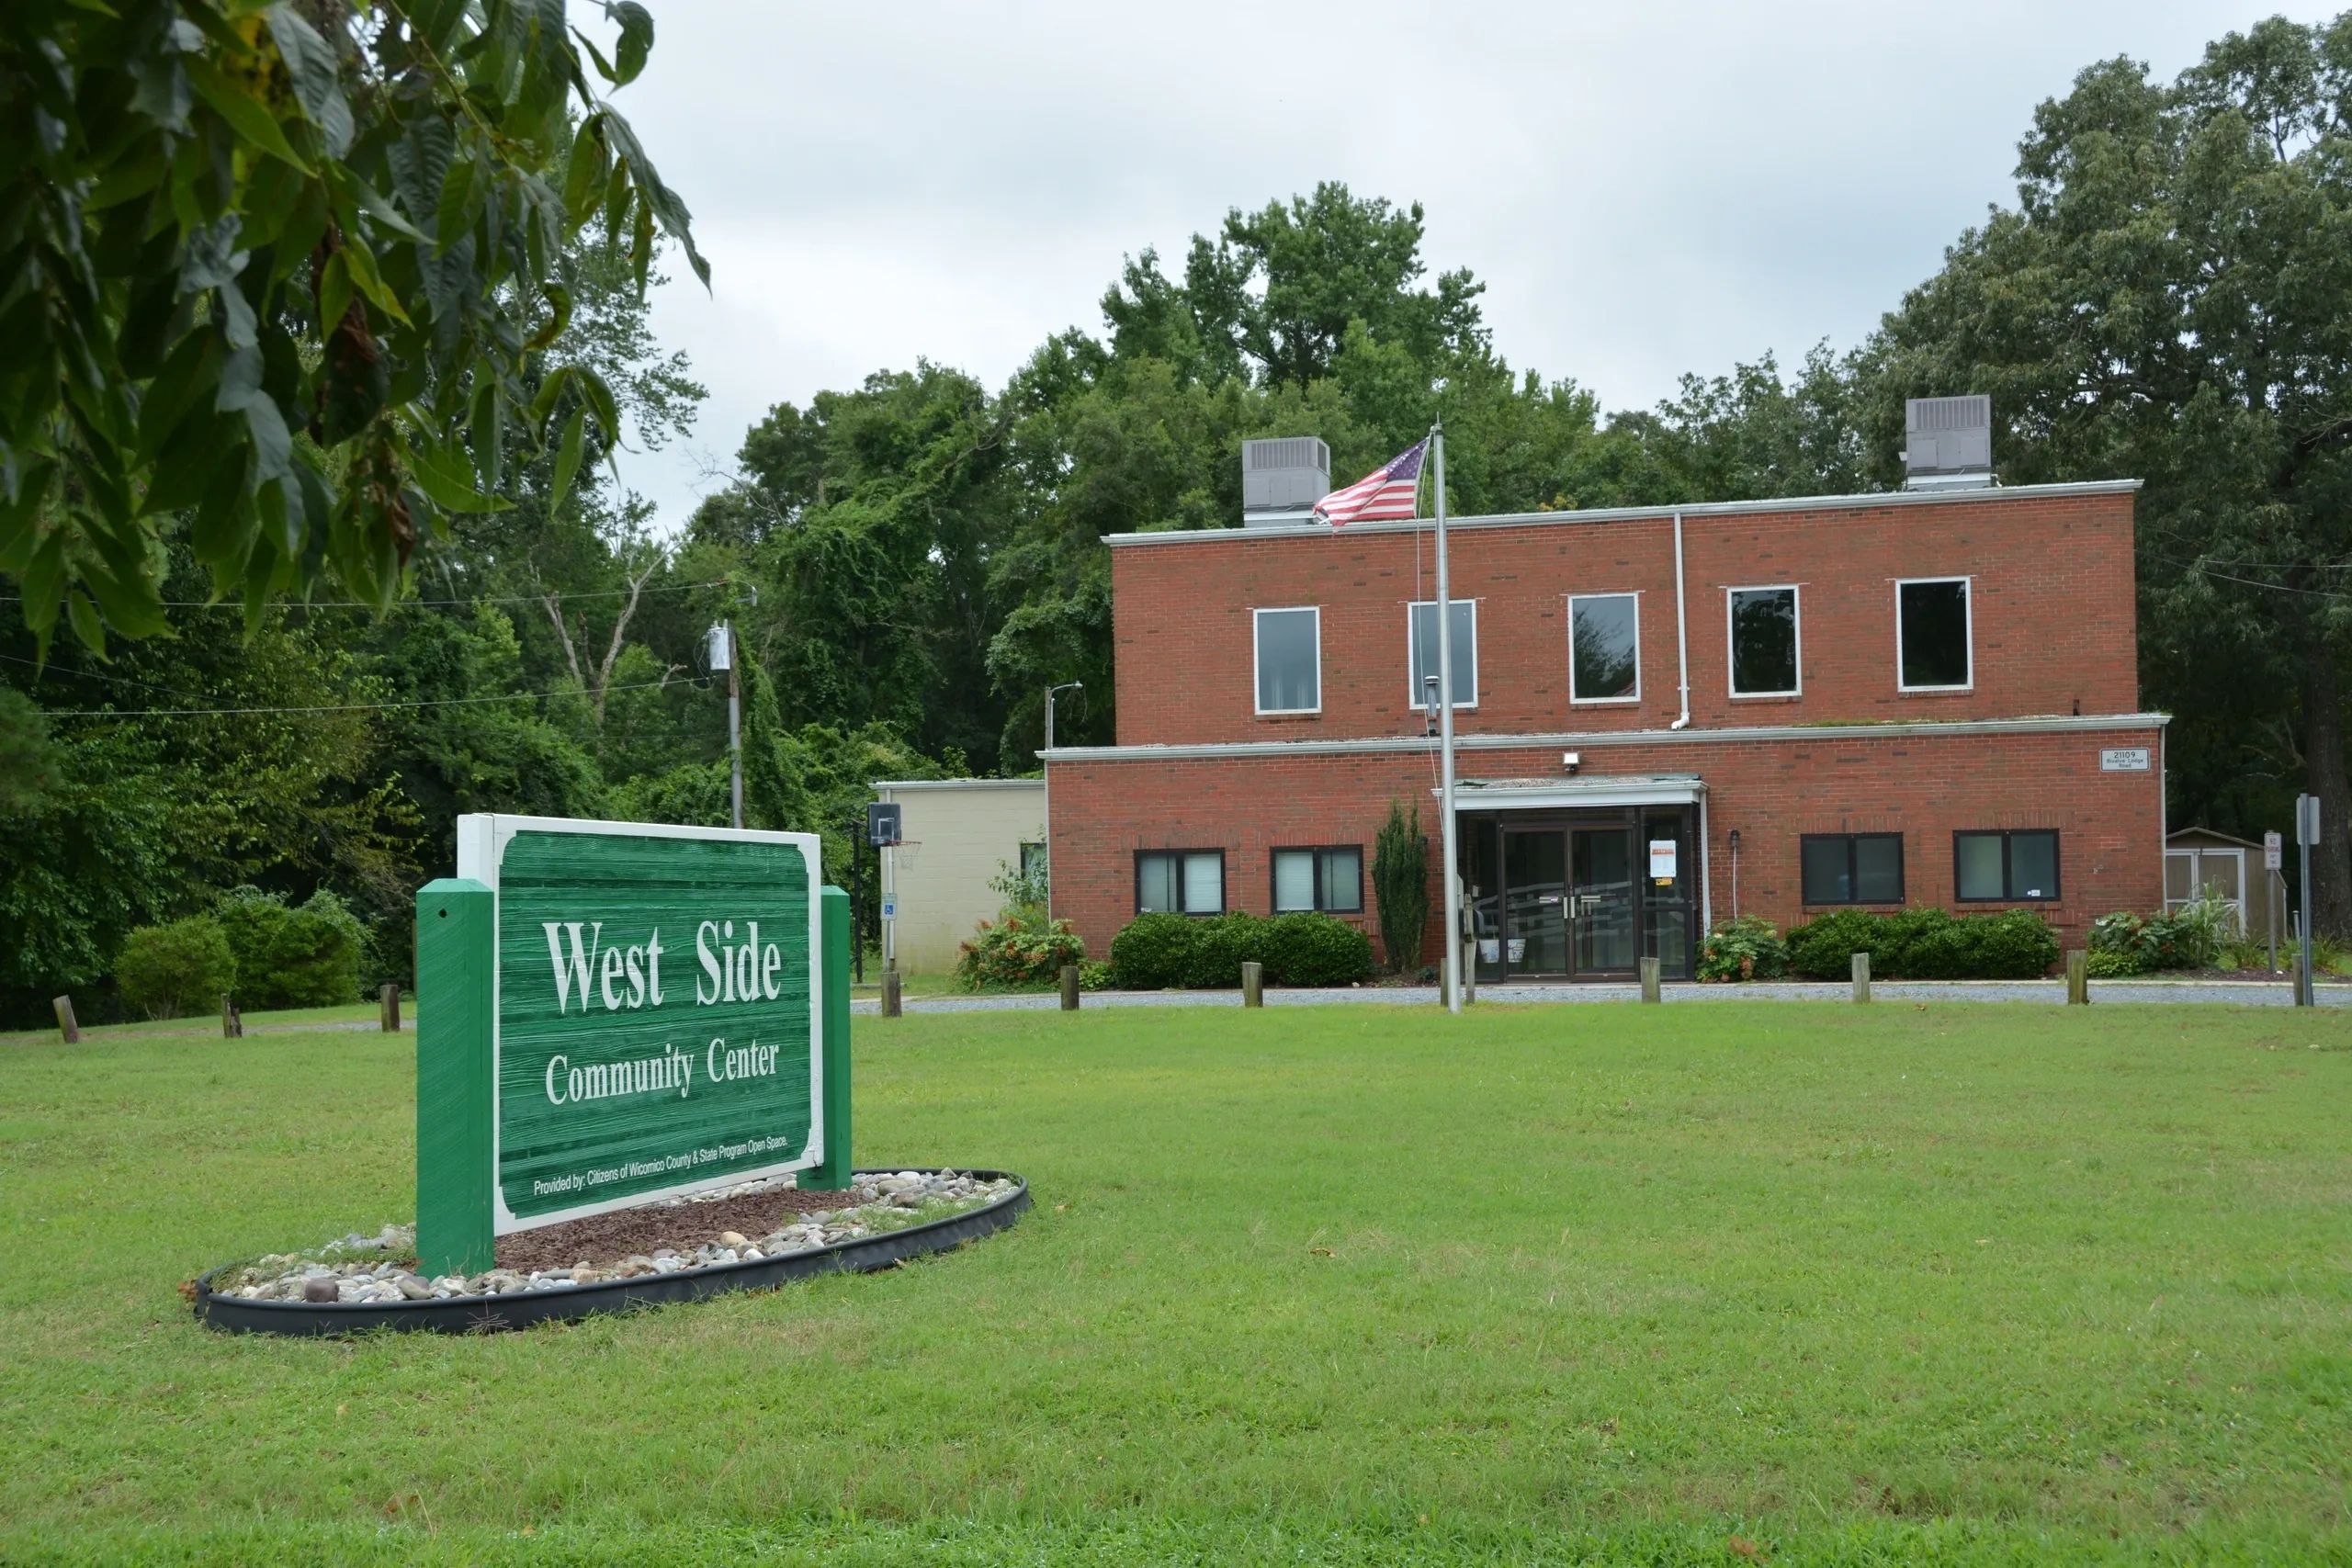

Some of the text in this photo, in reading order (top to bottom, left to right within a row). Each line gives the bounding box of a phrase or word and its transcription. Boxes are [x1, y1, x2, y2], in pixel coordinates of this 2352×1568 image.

[542, 920, 781, 1014] West Side
[546, 1037, 779, 1105] Community Center
[534, 1136, 788, 1195] Provided by: Citizens of Wicomico County & State Program Open Space.
